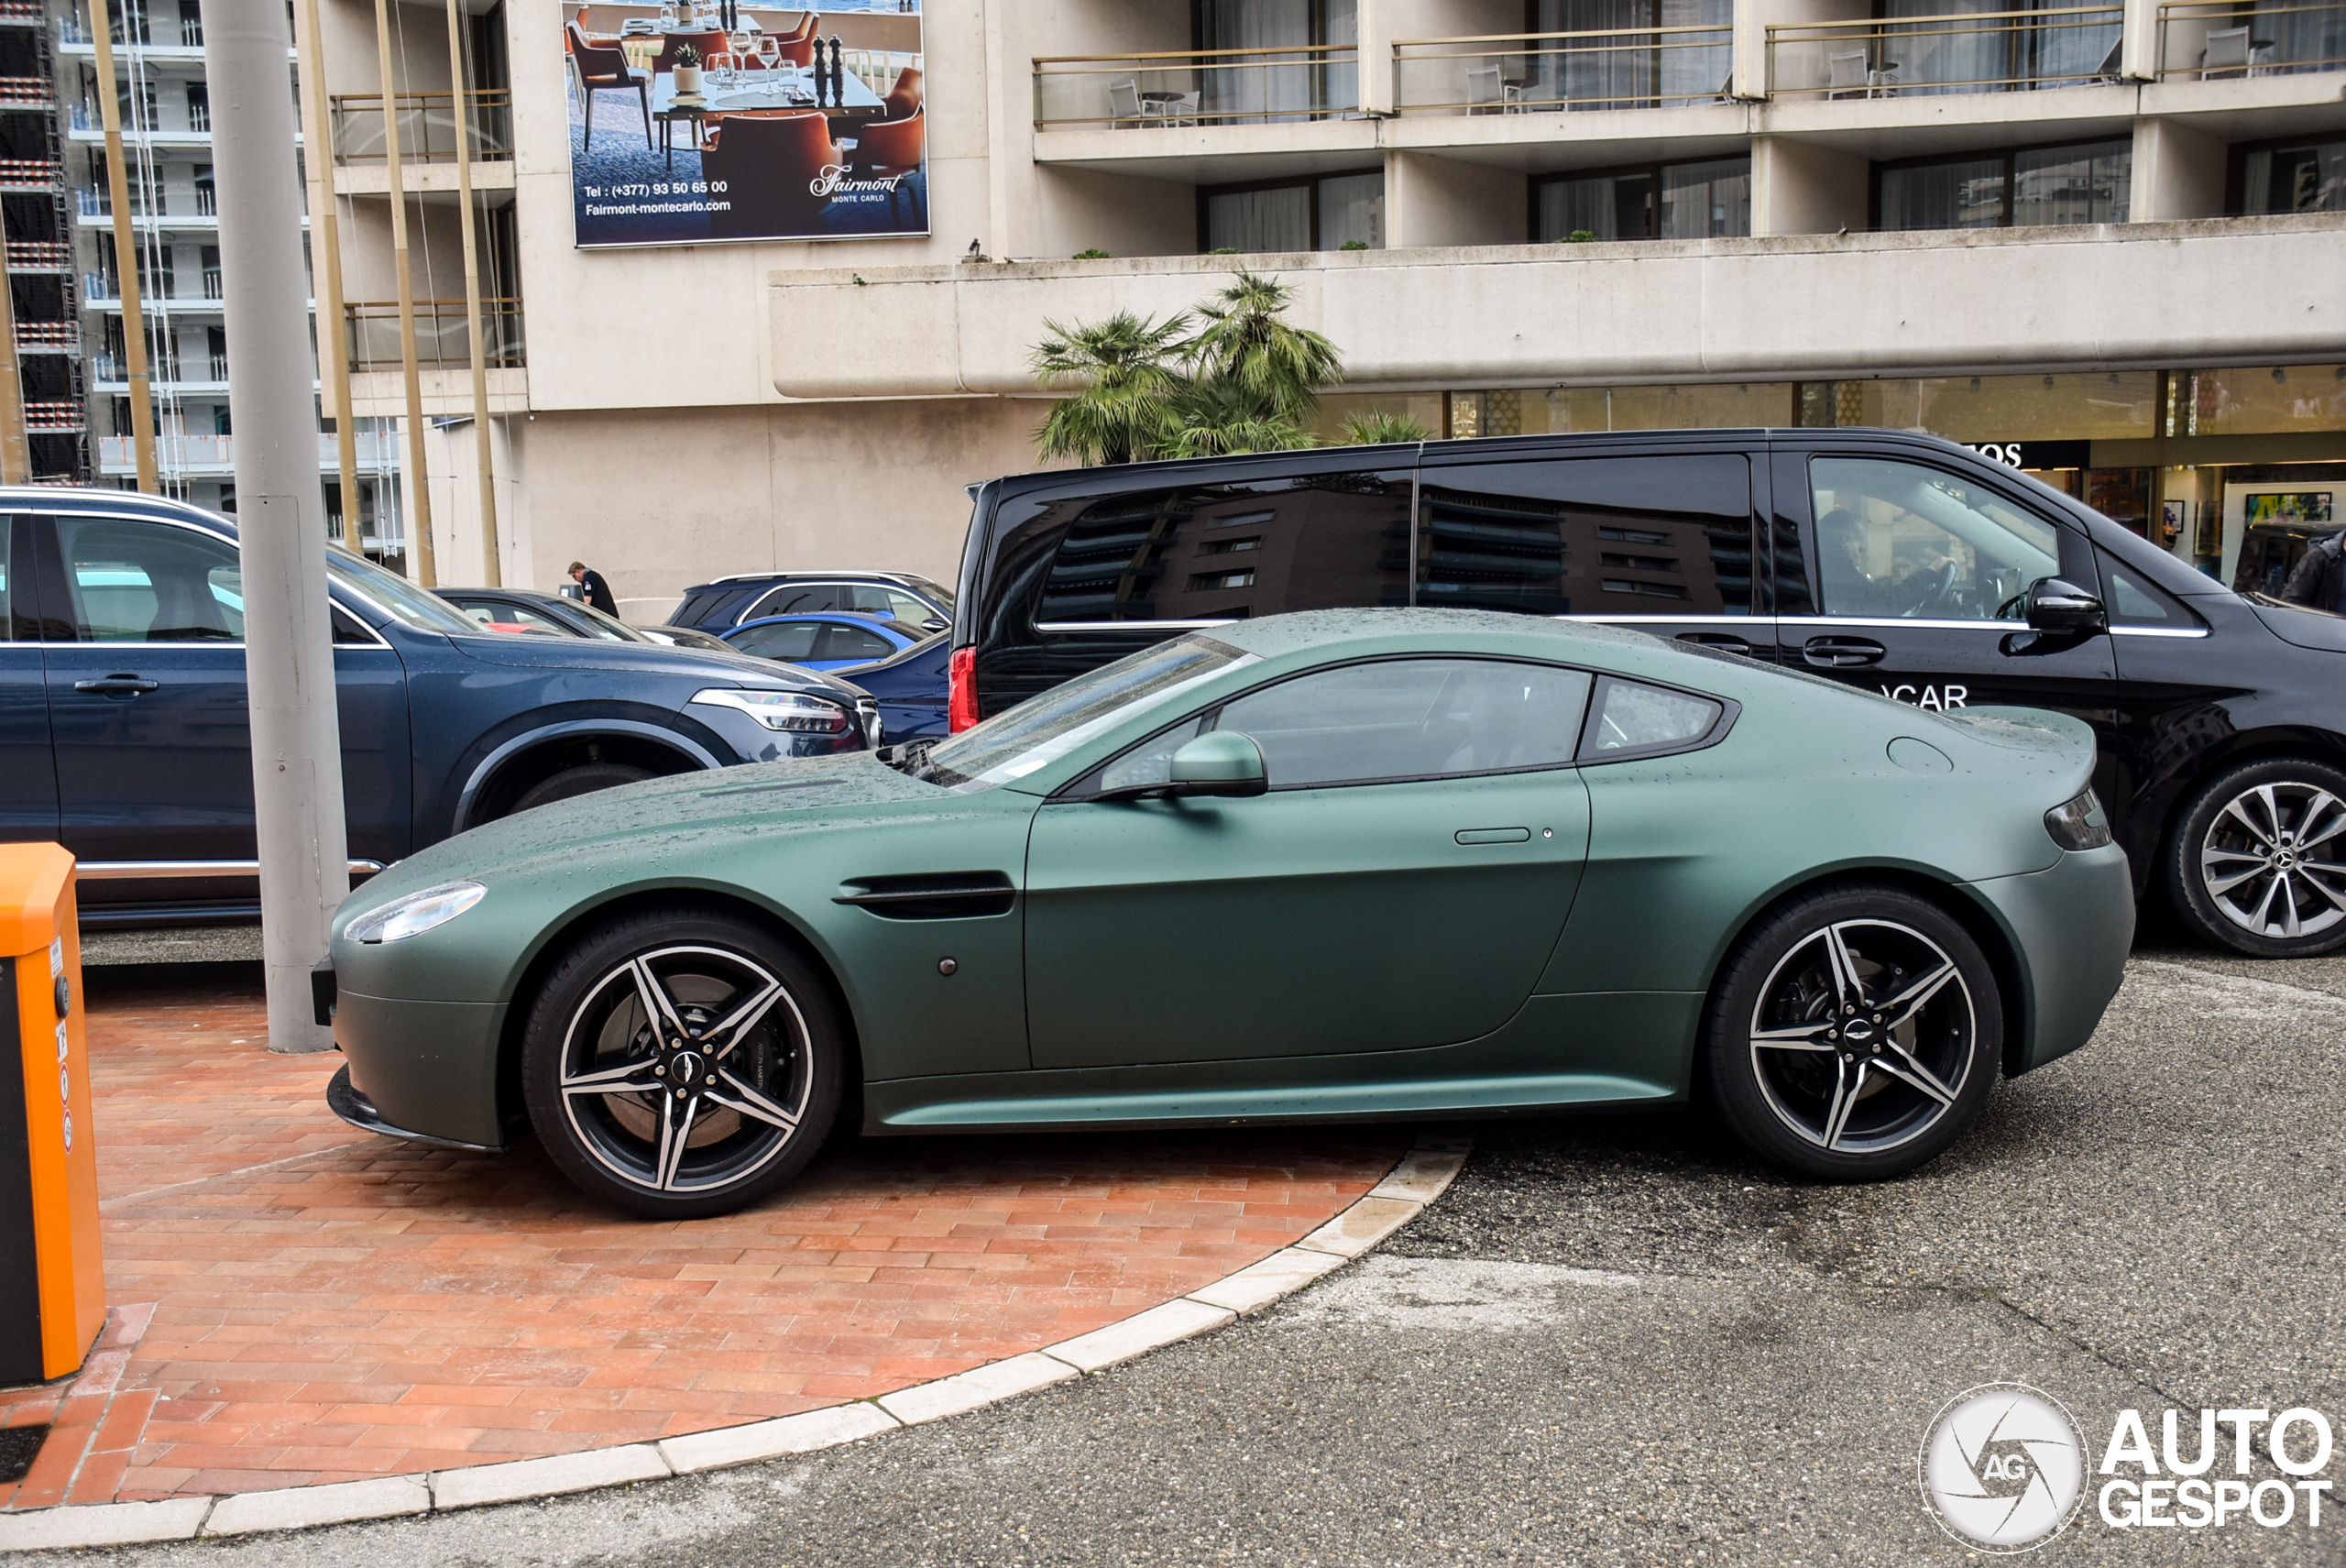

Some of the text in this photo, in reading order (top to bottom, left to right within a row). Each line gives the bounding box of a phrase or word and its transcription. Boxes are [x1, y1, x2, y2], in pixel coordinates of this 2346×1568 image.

[810, 164, 904, 197] Fairmont
[585, 186, 601, 197] Tel
[612, 184, 650, 198] (+377)
[652, 183, 669, 195] 93
[673, 182, 688, 194] 50
[692, 181, 707, 193] 65
[711, 181, 728, 192] 00
[832, 194, 884, 203] MONTE CARLO
[586, 201, 731, 215] Fairmont-montecarlo.com
